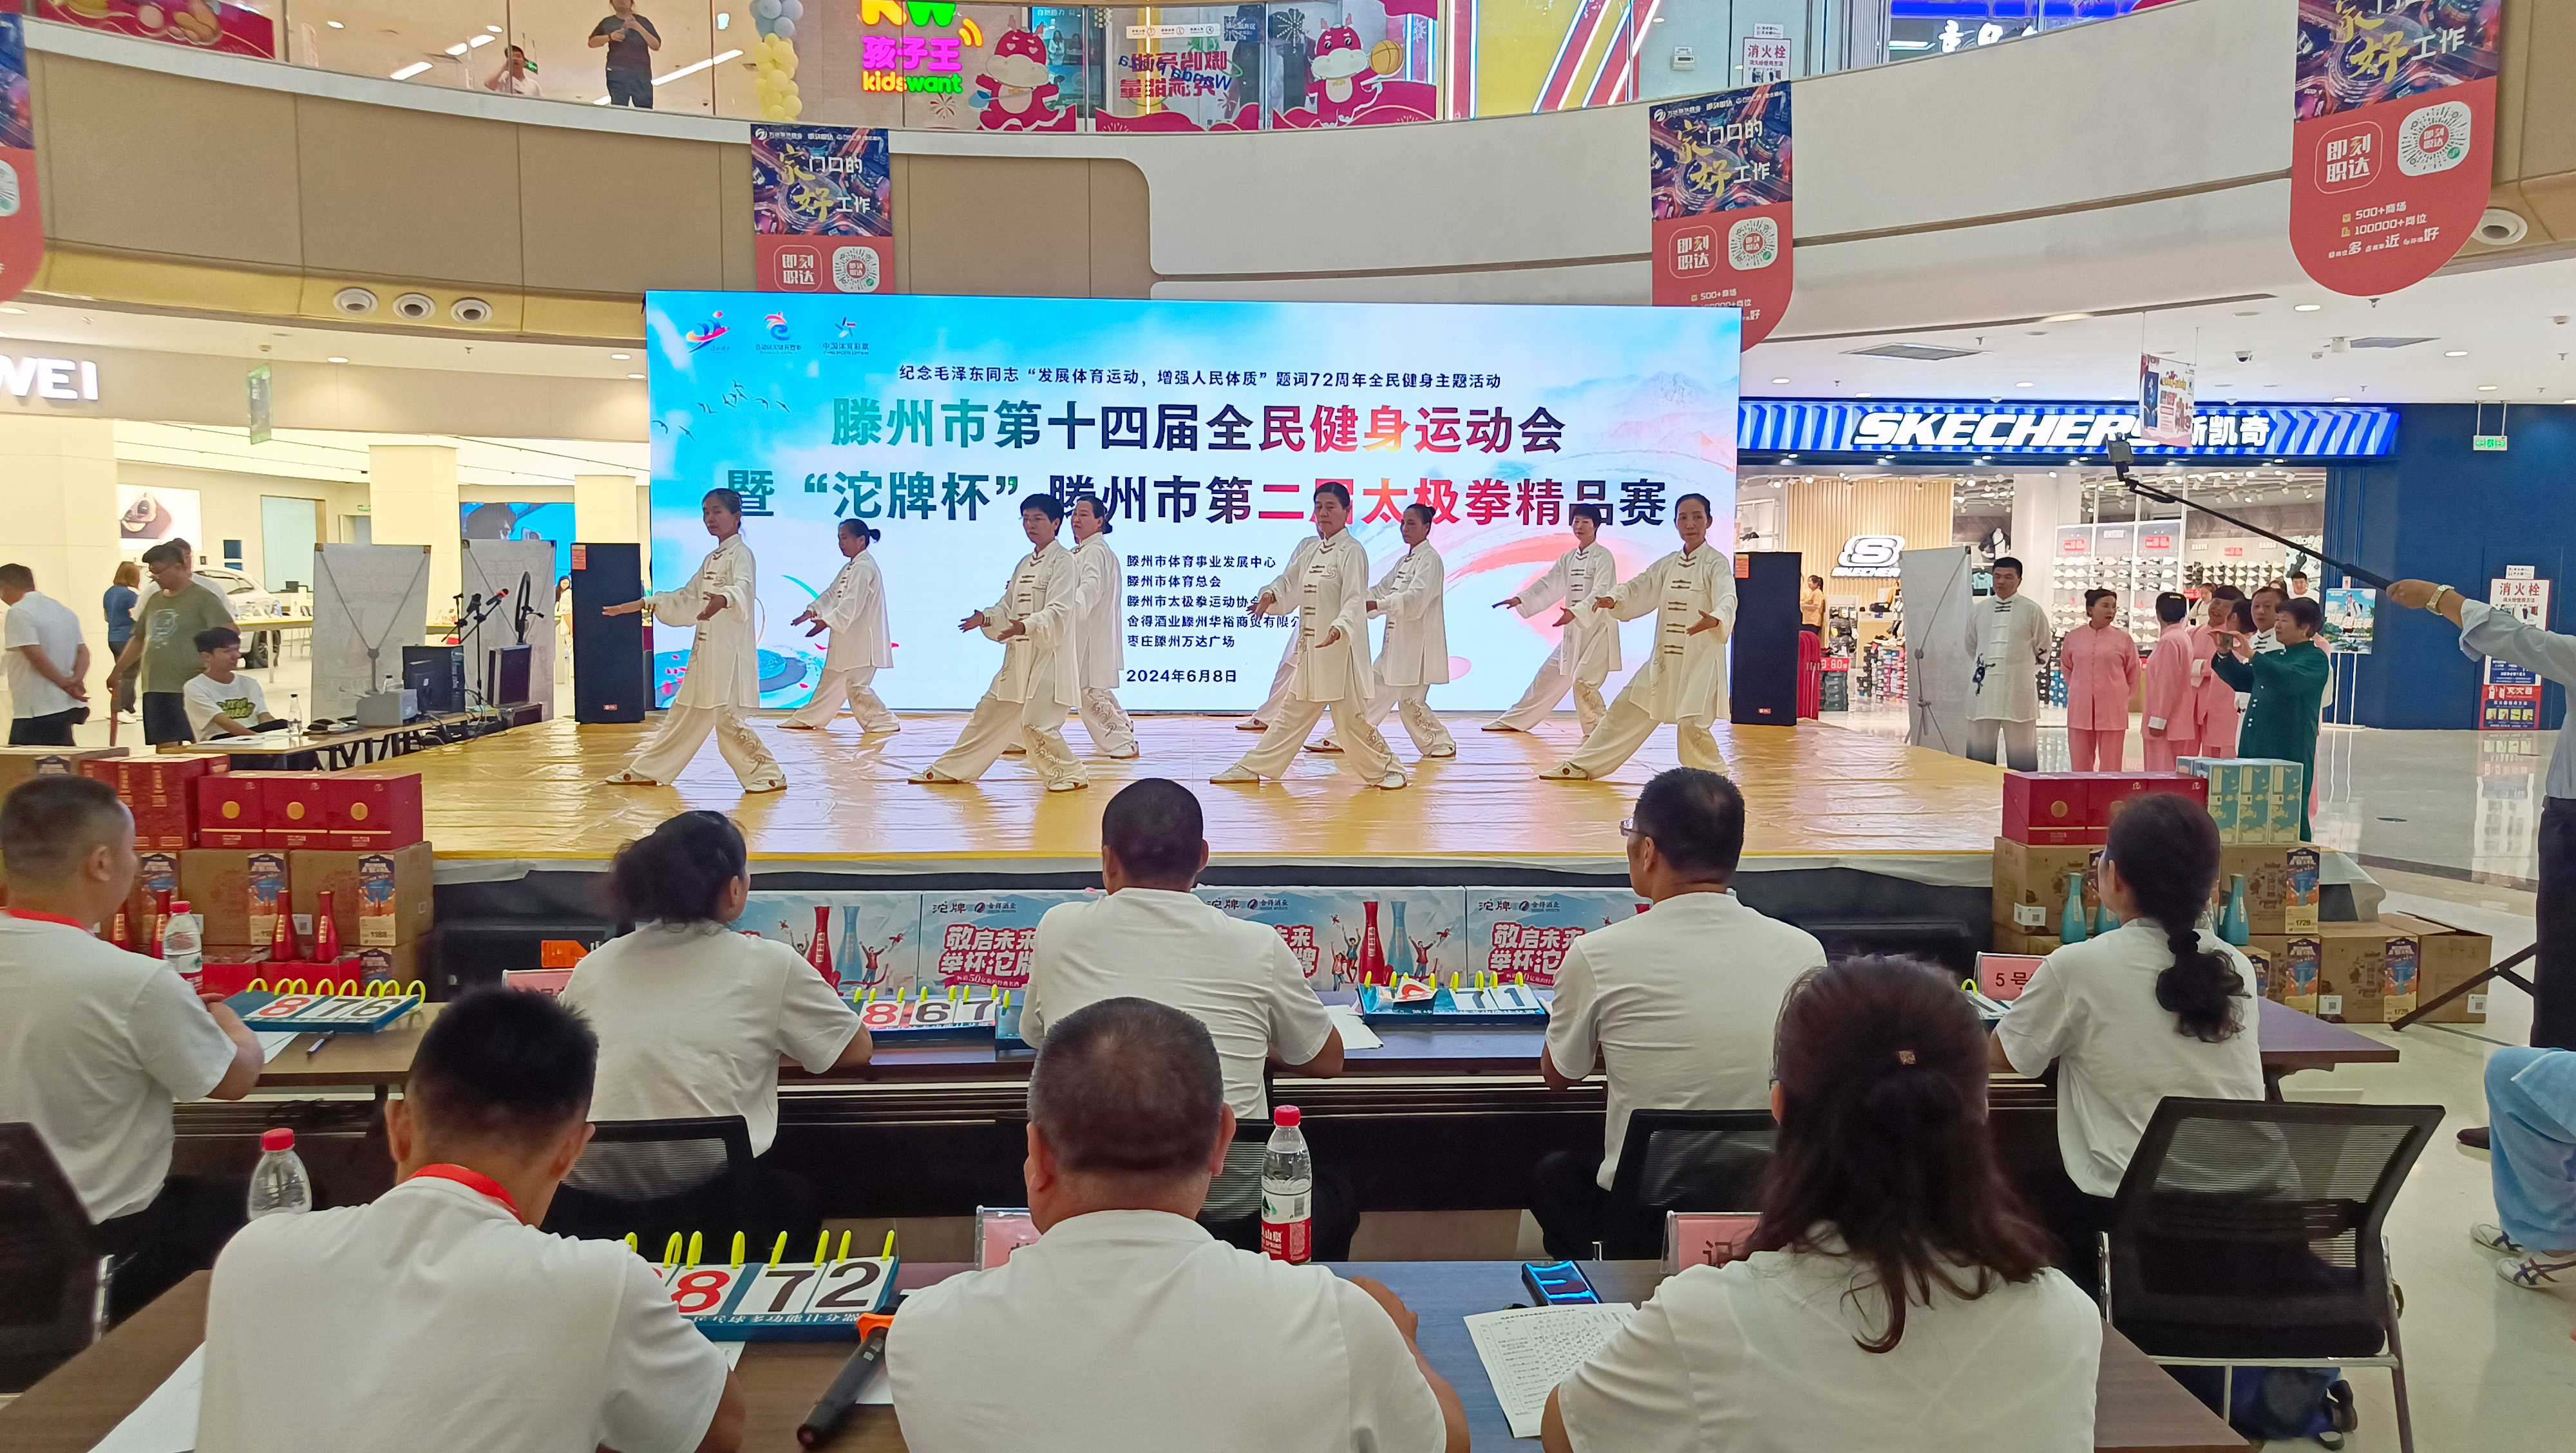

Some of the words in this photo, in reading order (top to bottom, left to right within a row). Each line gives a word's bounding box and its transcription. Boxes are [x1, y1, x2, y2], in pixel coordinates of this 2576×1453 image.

[862, 36, 962, 72] 孩子王
[1748, 44, 1786, 59] 消火栓
[862, 71, 963, 94] kidswant
[1677, 119, 1763, 164] 家门口的
[2327, 133, 2371, 162] 即刻
[777, 144, 862, 185] 家门口的
[2325, 159, 2371, 184] 职达
[1689, 159, 1770, 198] 好工作
[792, 187, 870, 222] 好工作
[2355, 201, 2407, 220] 500+商场
[1677, 234, 1709, 254] 即刻
[782, 254, 814, 269] 即刻
[1677, 252, 1710, 271] 职达
[783, 270, 815, 285] 职达
[831, 397, 1566, 453] 滕州市第十四届全民健身运动会
[1127, 555, 1276, 569] 滕州市体育事业发展中心
[1127, 575, 1222, 588] 滕州市体育总会
[2499, 582, 2540, 596] 消火栓
[1127, 635, 1235, 648] 枣庄滕州万达广场
[1126, 669, 1236, 683] 2024年6月8日
[947, 926, 1036, 951] 敬启未来
[1494, 924, 1583, 949] 敬启未来
